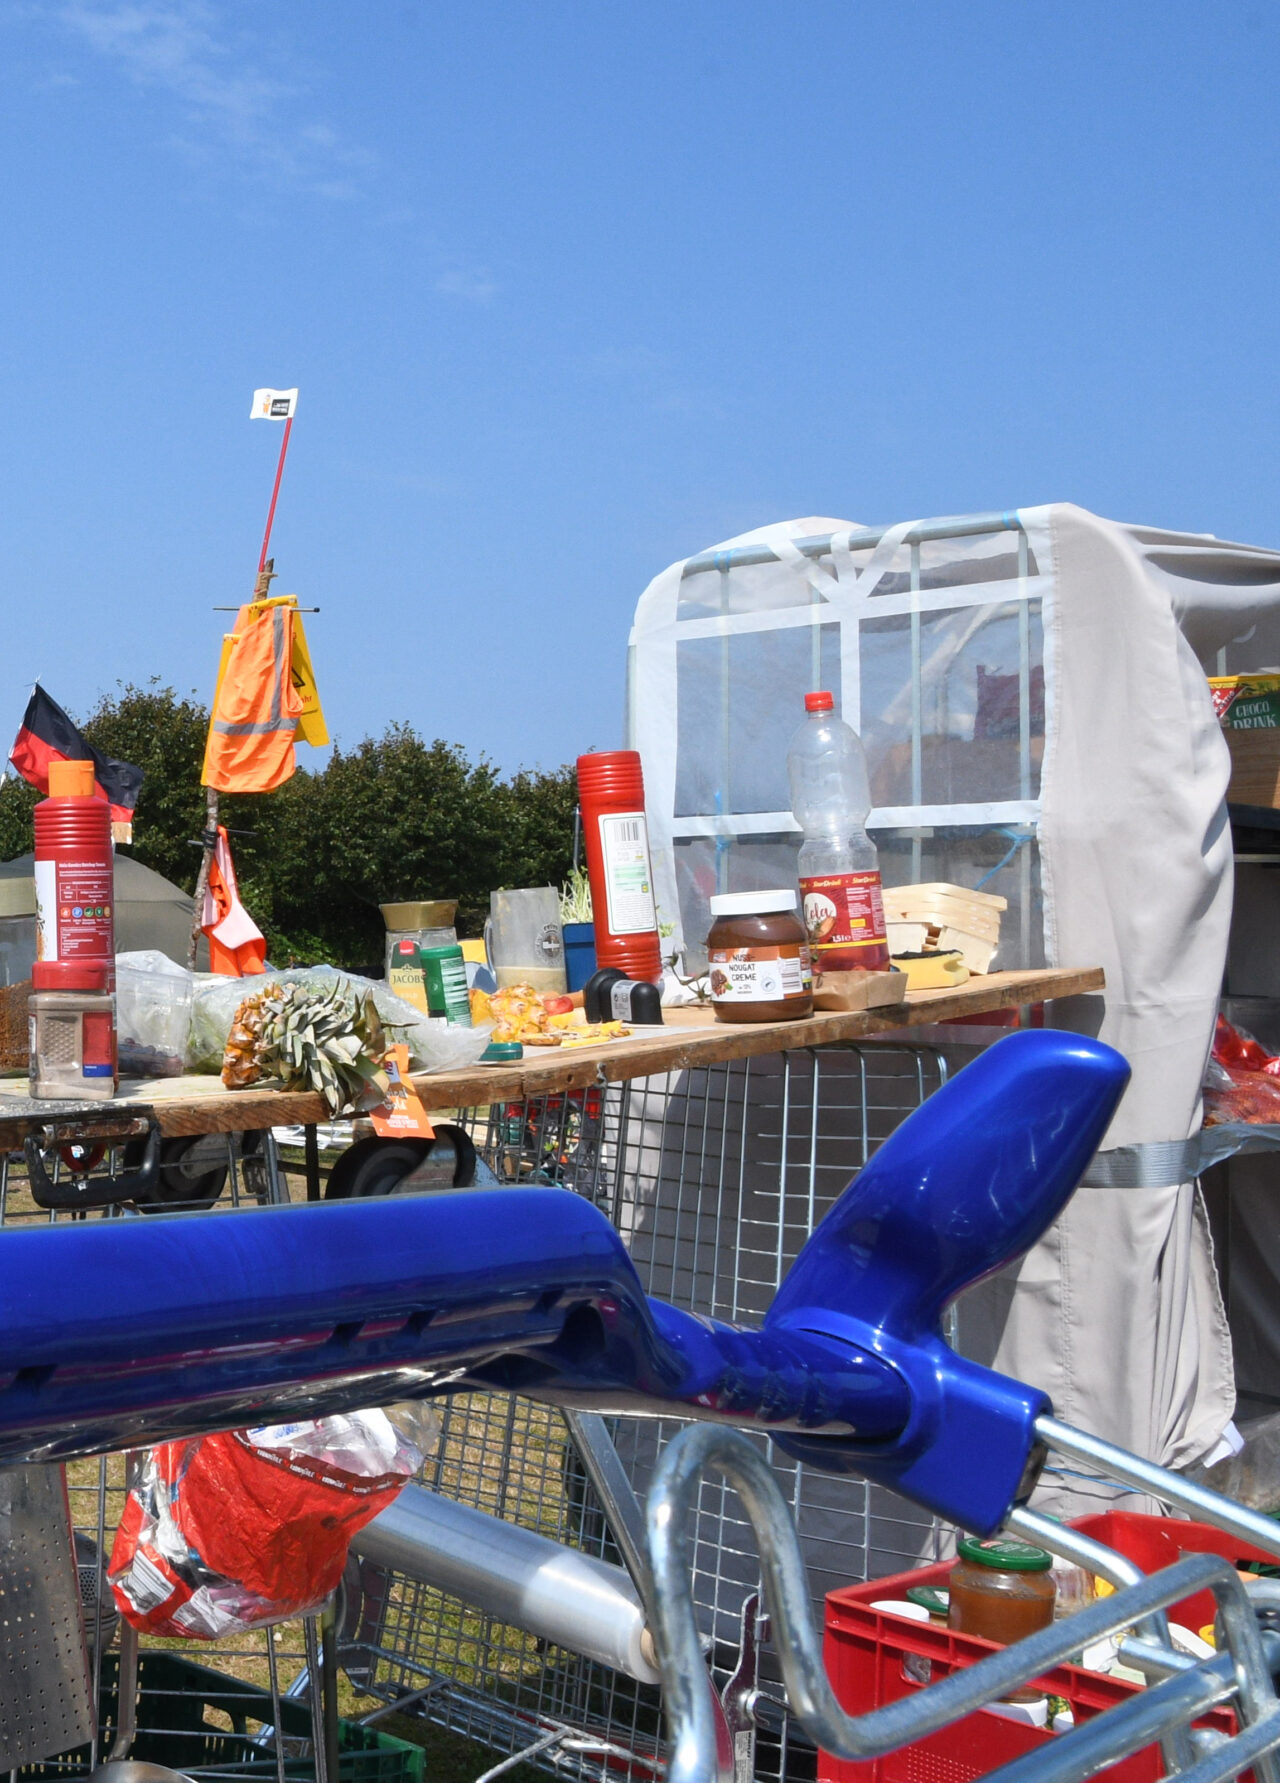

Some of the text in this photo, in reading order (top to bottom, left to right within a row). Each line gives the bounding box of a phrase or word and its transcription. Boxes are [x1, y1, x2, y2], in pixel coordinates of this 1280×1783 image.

[1235, 701, 1270, 717] CHOCO
[1233, 713, 1277, 729] DRINK
[728, 963, 756, 972] NOUGAT
[393, 975, 424, 984] JACOBS
[731, 972, 757, 982] CREME
